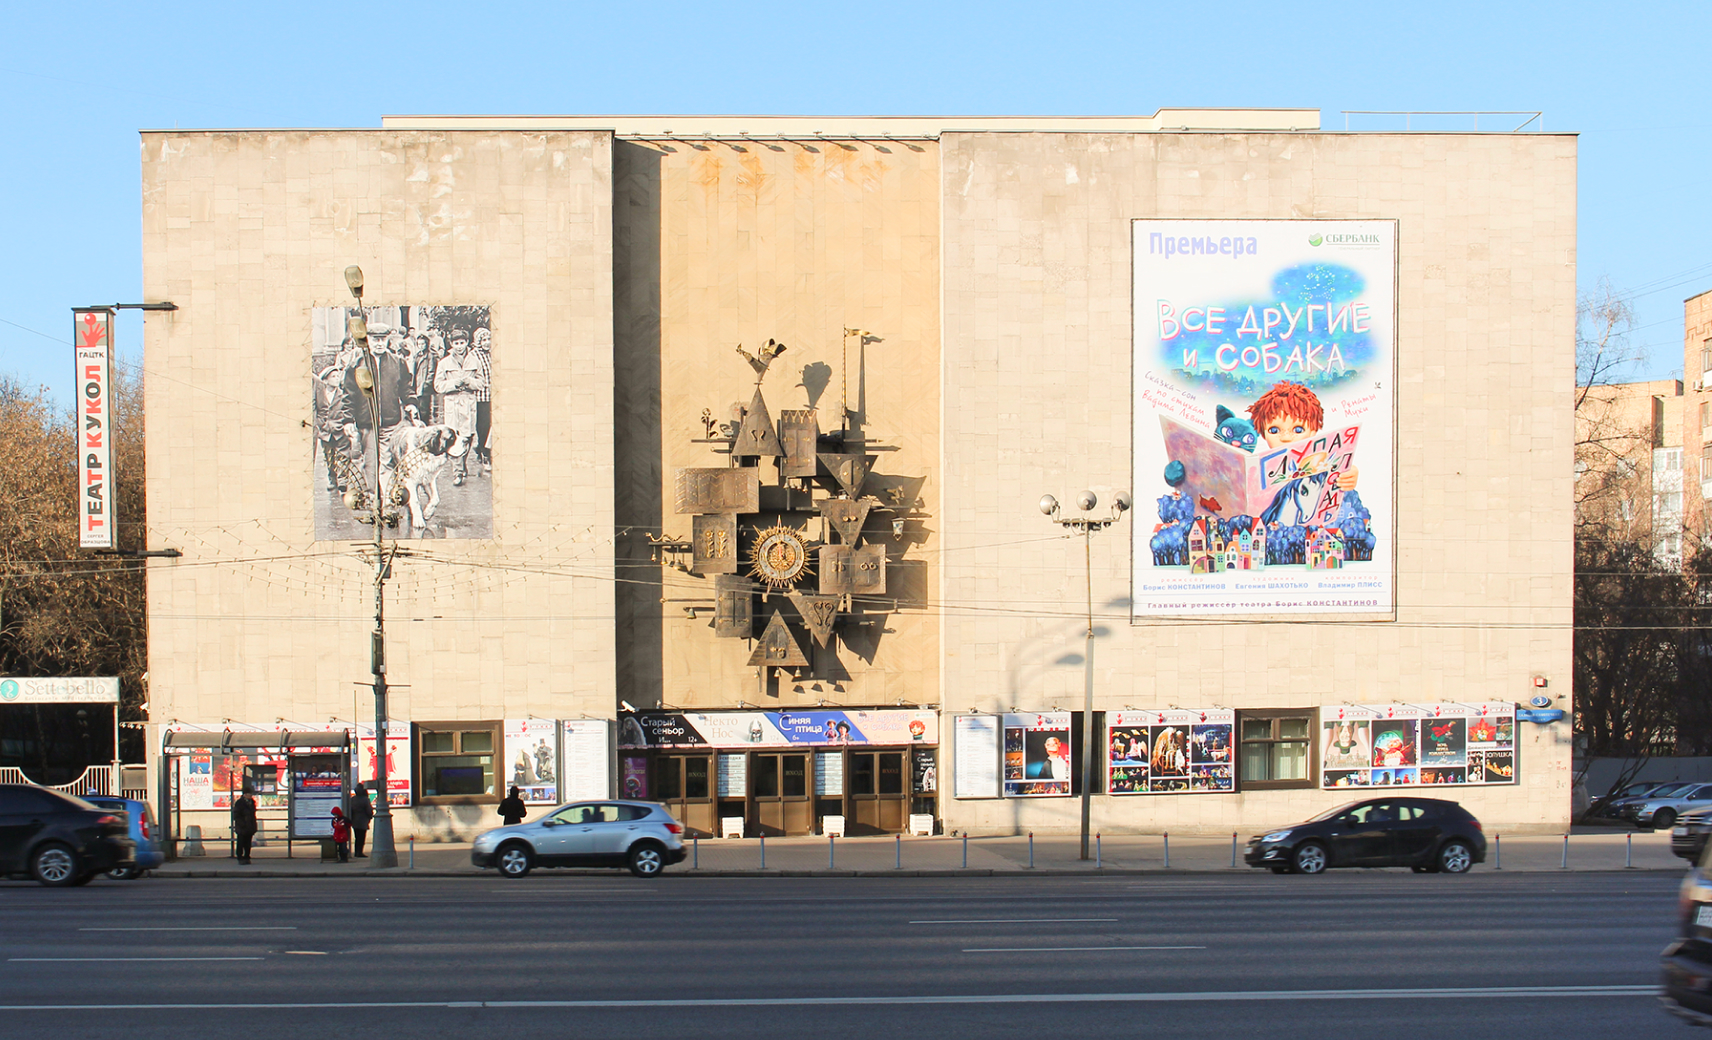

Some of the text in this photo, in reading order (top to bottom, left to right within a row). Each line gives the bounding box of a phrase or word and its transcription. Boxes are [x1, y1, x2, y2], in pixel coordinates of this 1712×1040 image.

[1150, 232, 1257, 259] Премьера
[1326, 234, 1380, 243] СБЕРБАНК
[1157, 300, 1371, 341] ВСЕ ДРУГИЕ
[1215, 342, 1345, 374] СОБАКА
[1156, 389, 1204, 415] по стихам
[86, 365, 104, 531] ТЕАТР КУКОЛ
[24, 680, 106, 695] Settebello
[641, 716, 676, 728] Старый
[704, 716, 738, 726] Некто
[780, 714, 812, 730] Синяя
[652, 728, 684, 736] сеньор
[712, 728, 734, 738] Нос
[795, 726, 822, 734] птица
